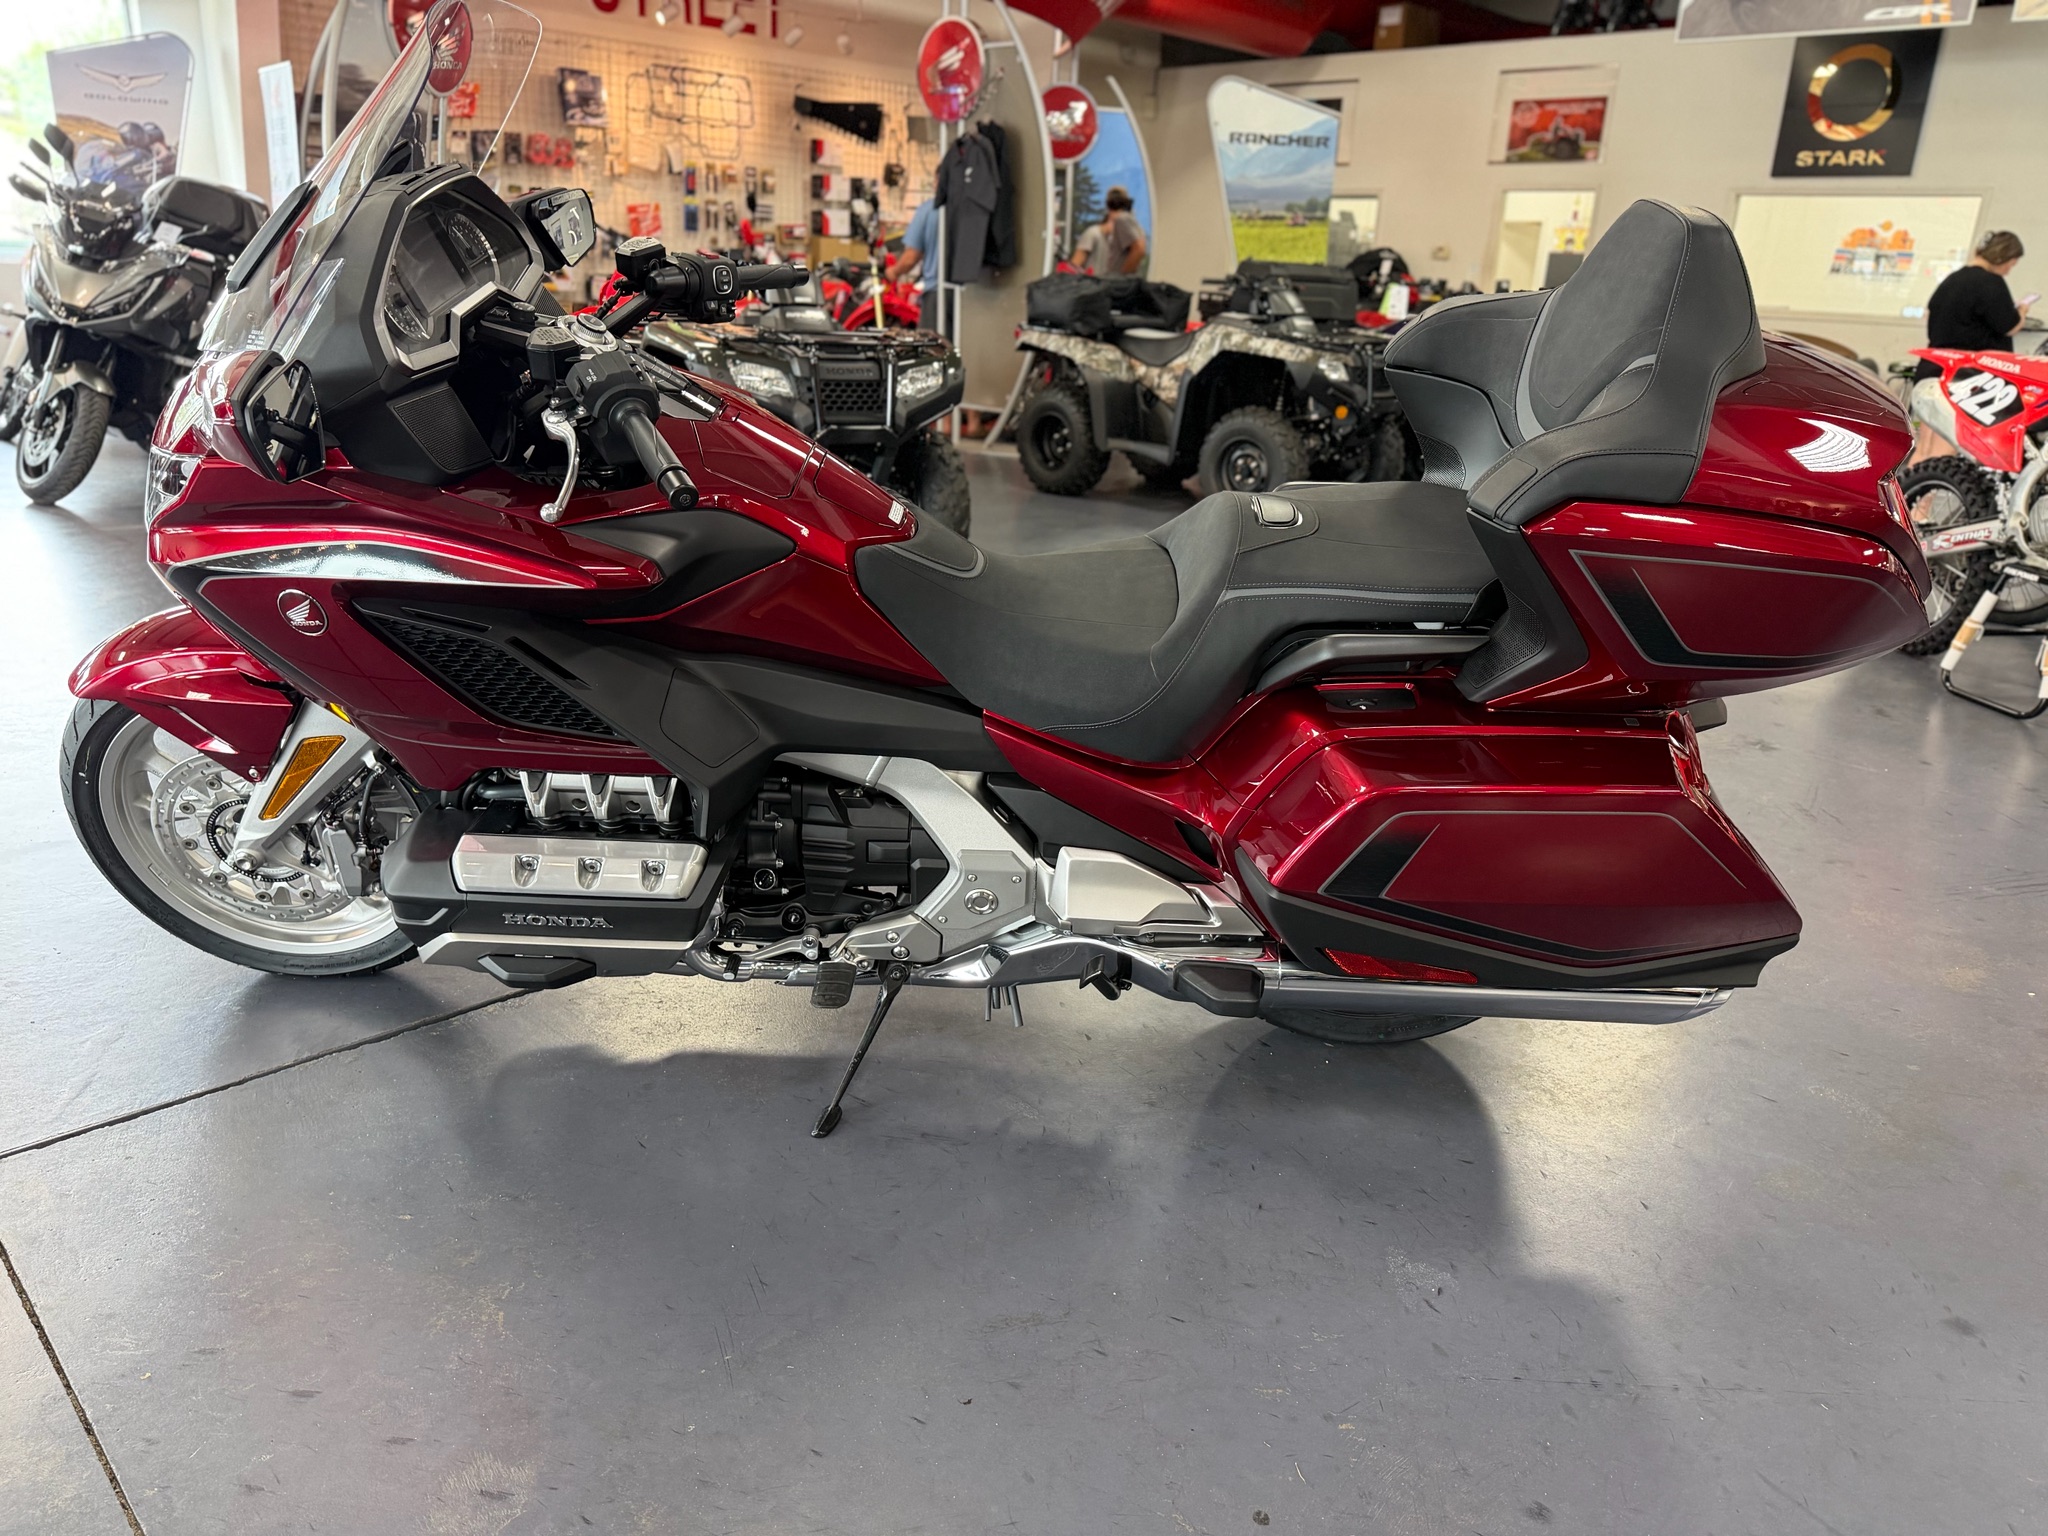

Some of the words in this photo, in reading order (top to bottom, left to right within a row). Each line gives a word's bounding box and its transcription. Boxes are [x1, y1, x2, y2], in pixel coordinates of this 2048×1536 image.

[1228, 131, 1332, 149] RANCHER
[1795, 149, 1886, 167] STARK
[1977, 355, 2022, 374] HONDA
[1948, 371, 2019, 426] 422
[502, 913, 614, 929] HONDA
